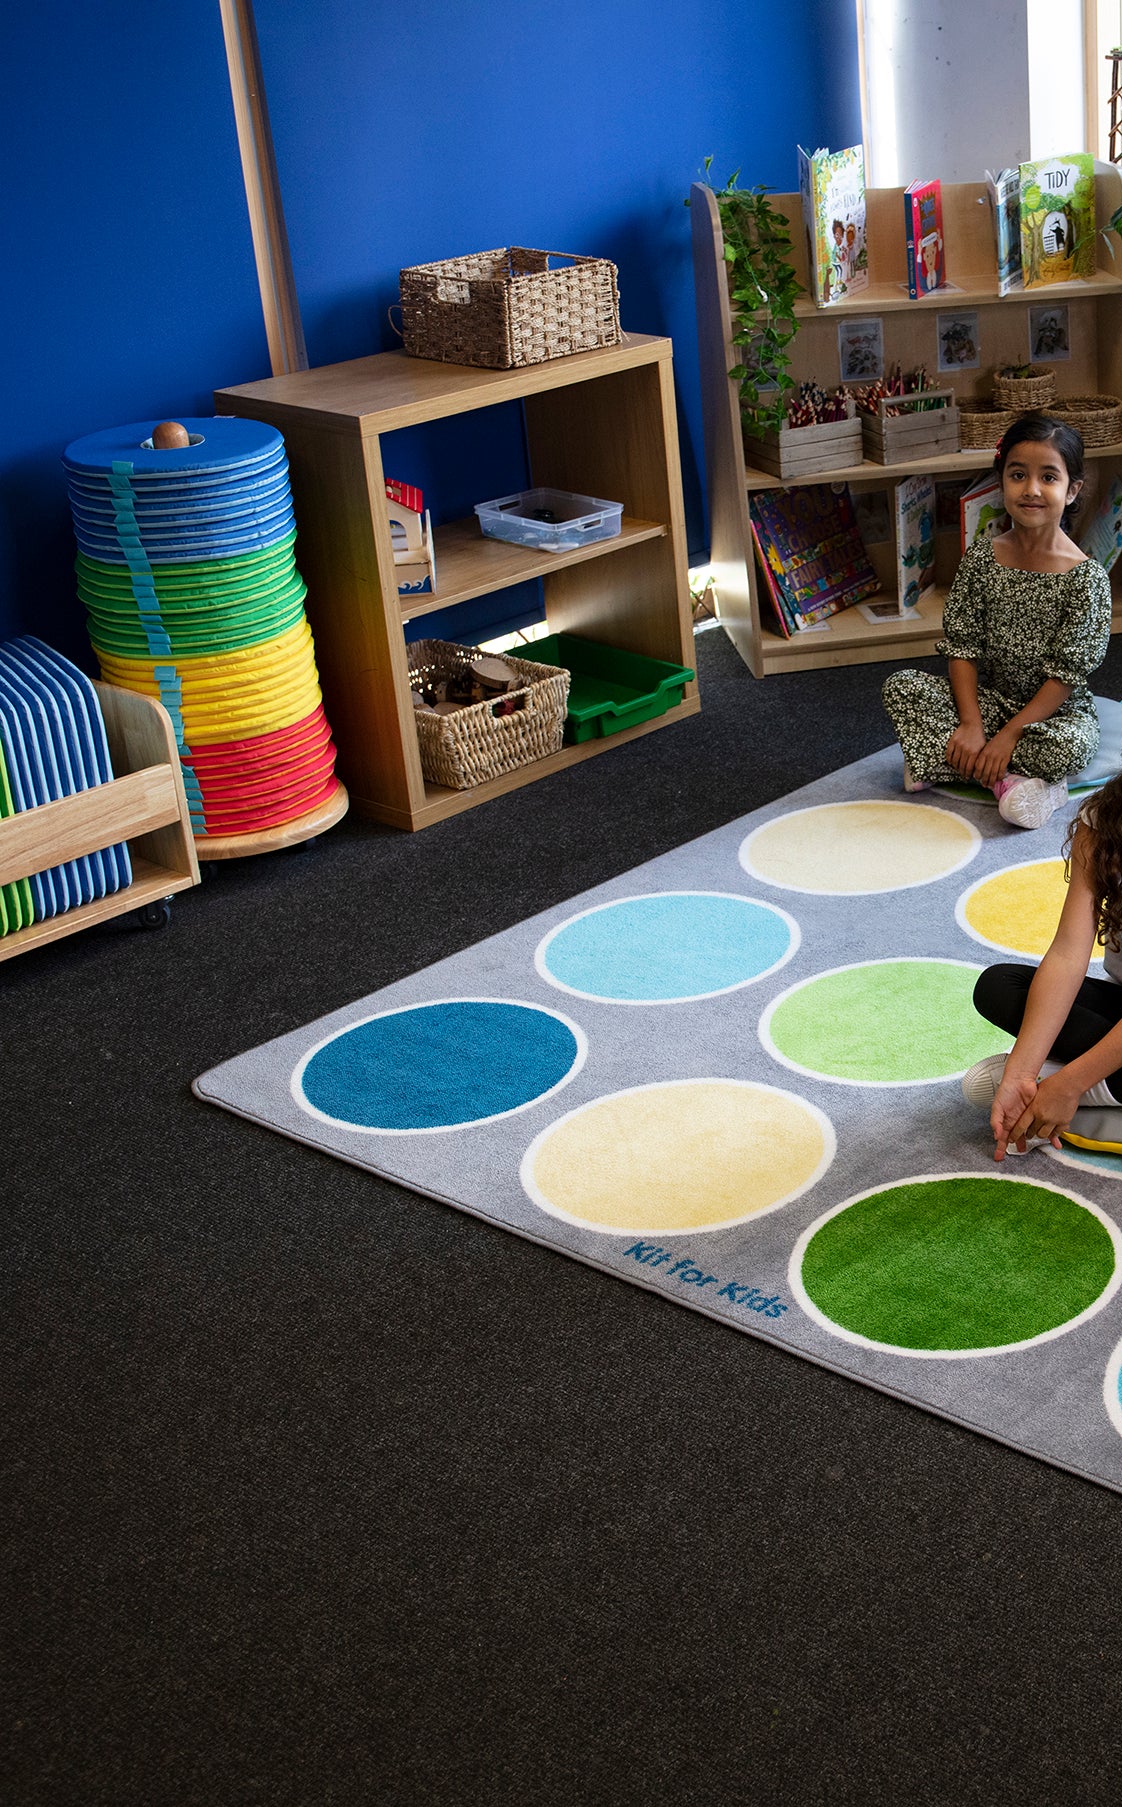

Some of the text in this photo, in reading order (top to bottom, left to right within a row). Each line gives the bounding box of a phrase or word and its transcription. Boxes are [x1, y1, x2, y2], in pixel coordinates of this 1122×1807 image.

[776, 484, 834, 530] YOU
[787, 514, 842, 553] CHOOSE
[790, 538, 865, 589] FAIRY TALES
[623, 1241, 788, 1318] Kit for Kids
